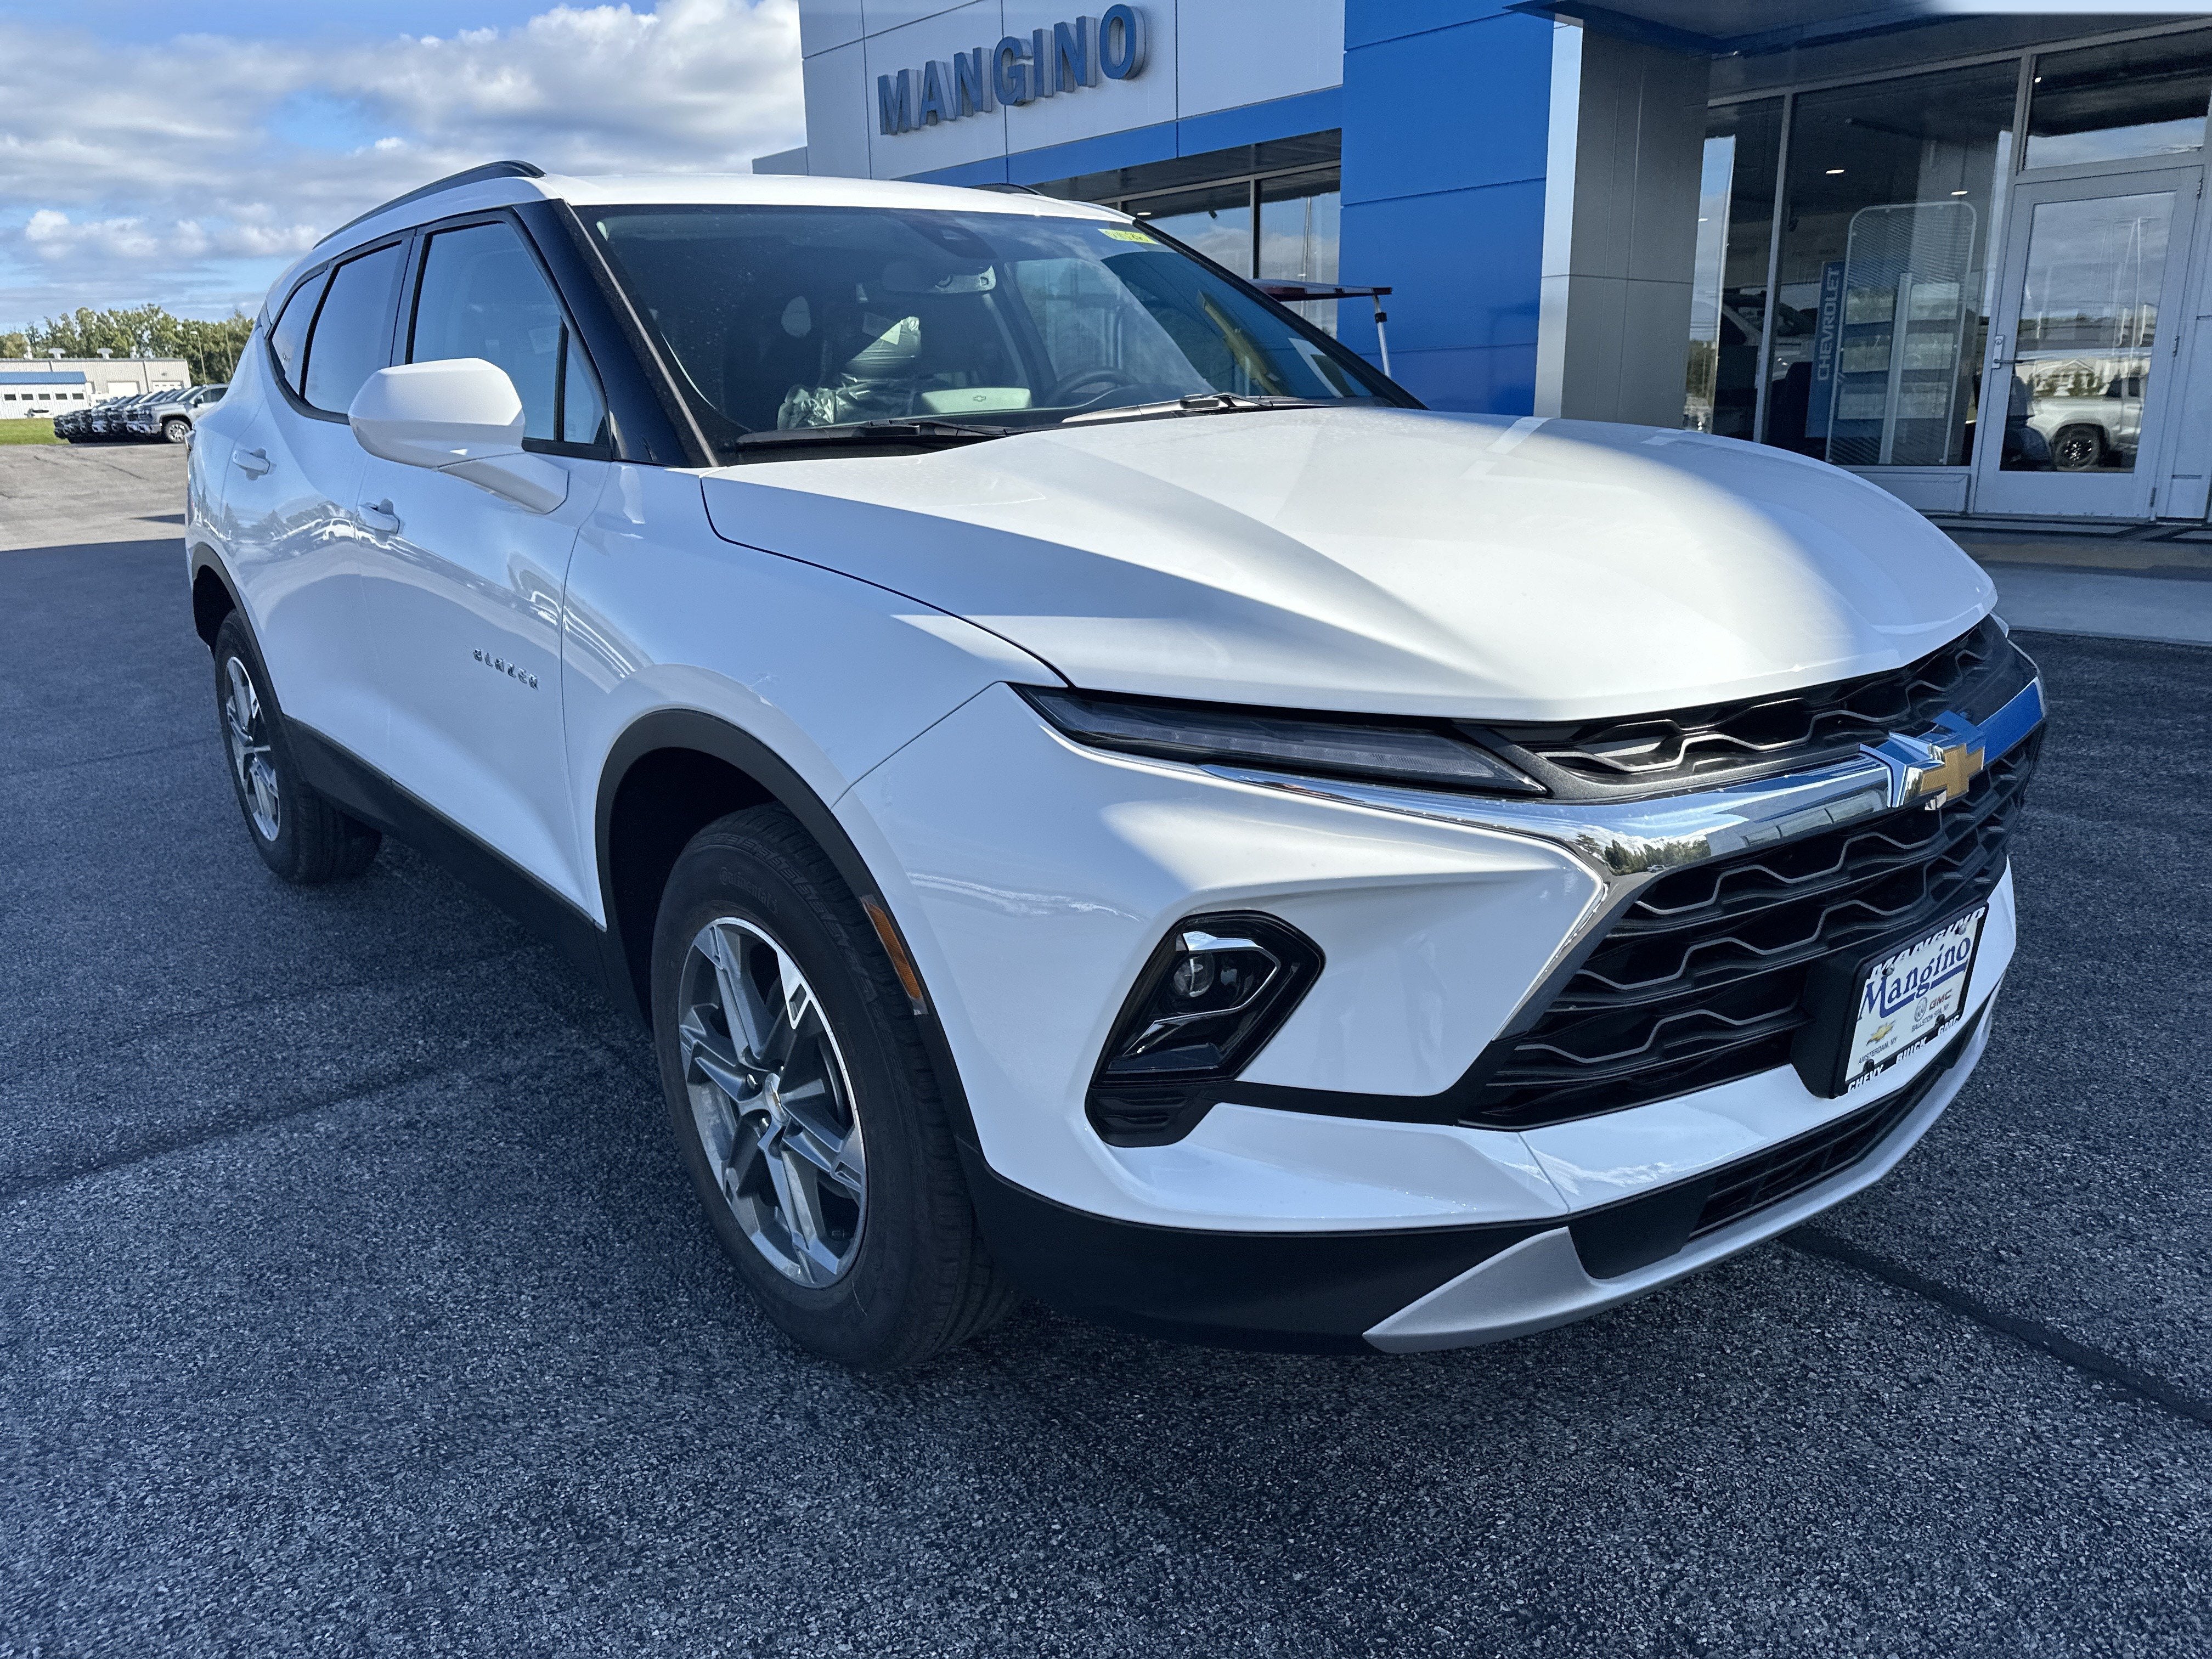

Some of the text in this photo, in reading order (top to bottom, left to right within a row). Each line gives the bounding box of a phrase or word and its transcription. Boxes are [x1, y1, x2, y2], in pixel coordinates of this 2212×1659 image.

[878, 4, 1144, 135] MANGINO
[1818, 267, 1839, 380] CHEVROLET
[473, 648, 539, 691] BLAZER
[1857, 938, 1971, 1019] Mangino
[1869, 907, 1985, 979] MANGINO
[1911, 1014, 1933, 1032] BALLSTON
[1929, 989, 1952, 1010] GMC
[1848, 1015, 1959, 1093] CHEVY BUICK GMC
[1891, 1036, 1898, 1046] NY
